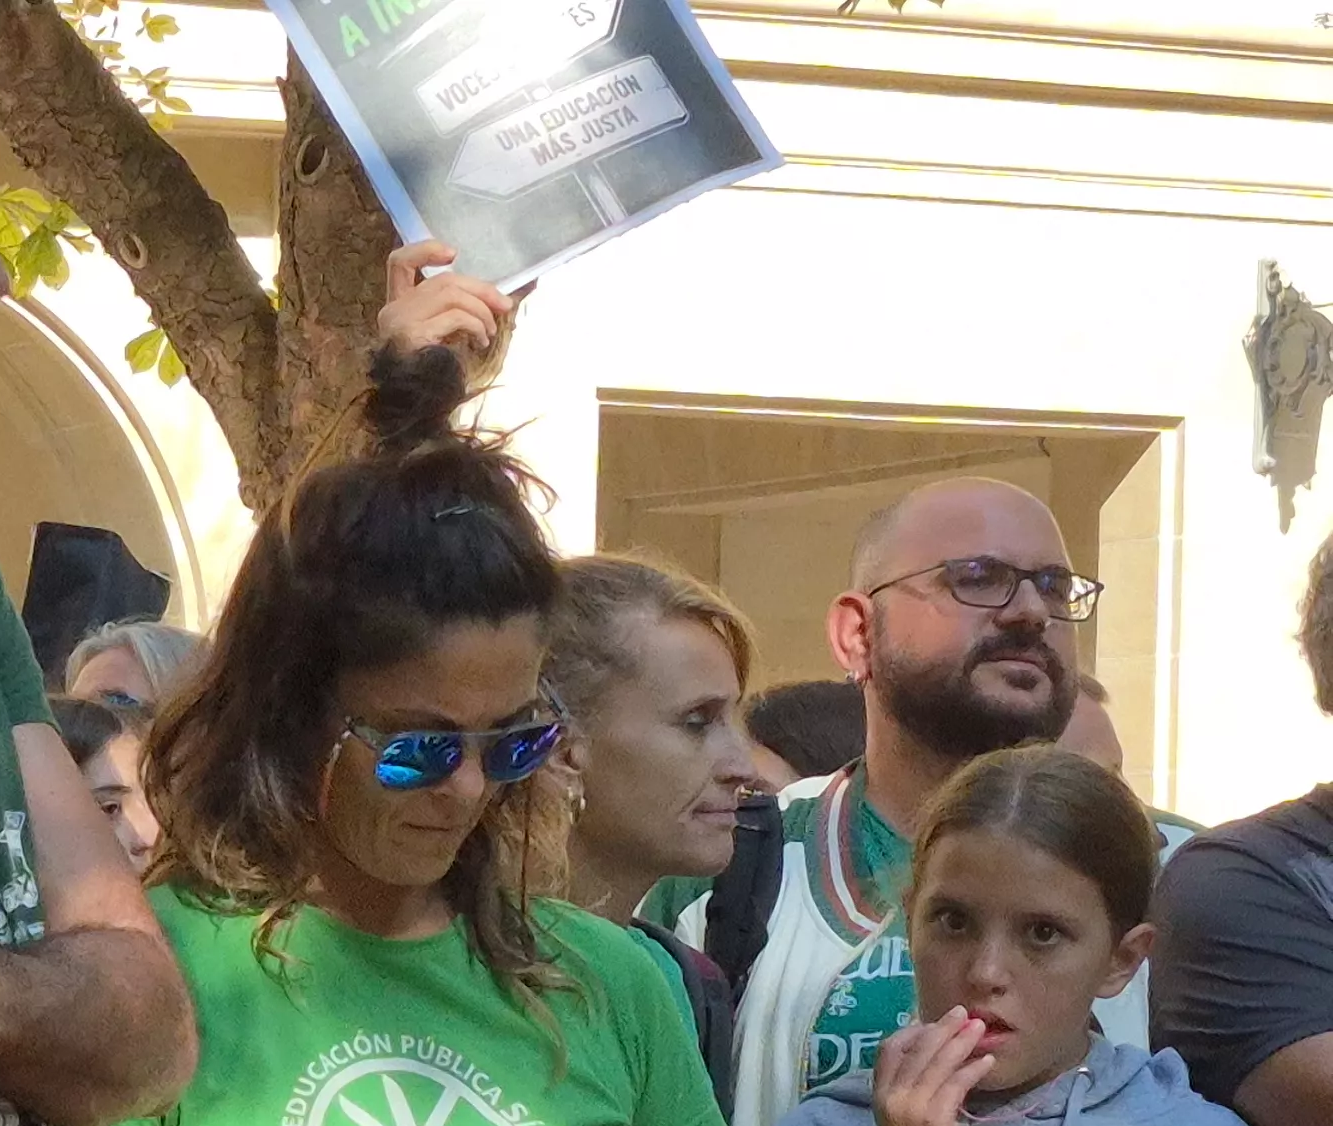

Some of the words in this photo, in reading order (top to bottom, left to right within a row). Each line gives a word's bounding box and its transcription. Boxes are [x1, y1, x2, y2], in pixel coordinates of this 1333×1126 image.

[339, 15, 370, 57] A
[494, 124, 539, 151] UNA
[538, 73, 643, 132] EDUCACIÓN
[529, 129, 577, 166] MÁS
[579, 105, 639, 145] JUSTA
[400, 1034, 503, 1107] PÚBLICA
